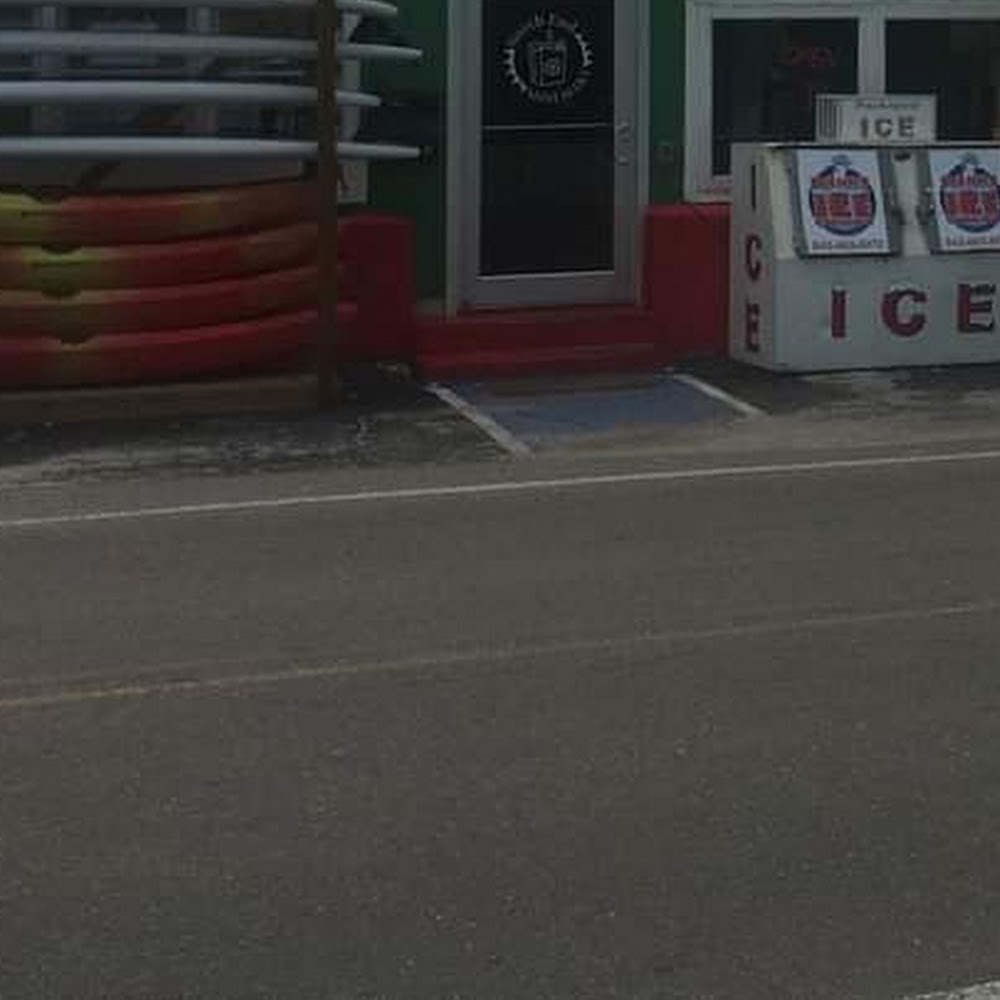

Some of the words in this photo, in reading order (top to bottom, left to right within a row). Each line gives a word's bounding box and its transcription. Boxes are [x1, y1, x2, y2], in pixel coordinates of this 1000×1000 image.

[860, 116, 915, 138] ICE
[745, 164, 762, 352] ICE
[831, 283, 997, 339] ICE
